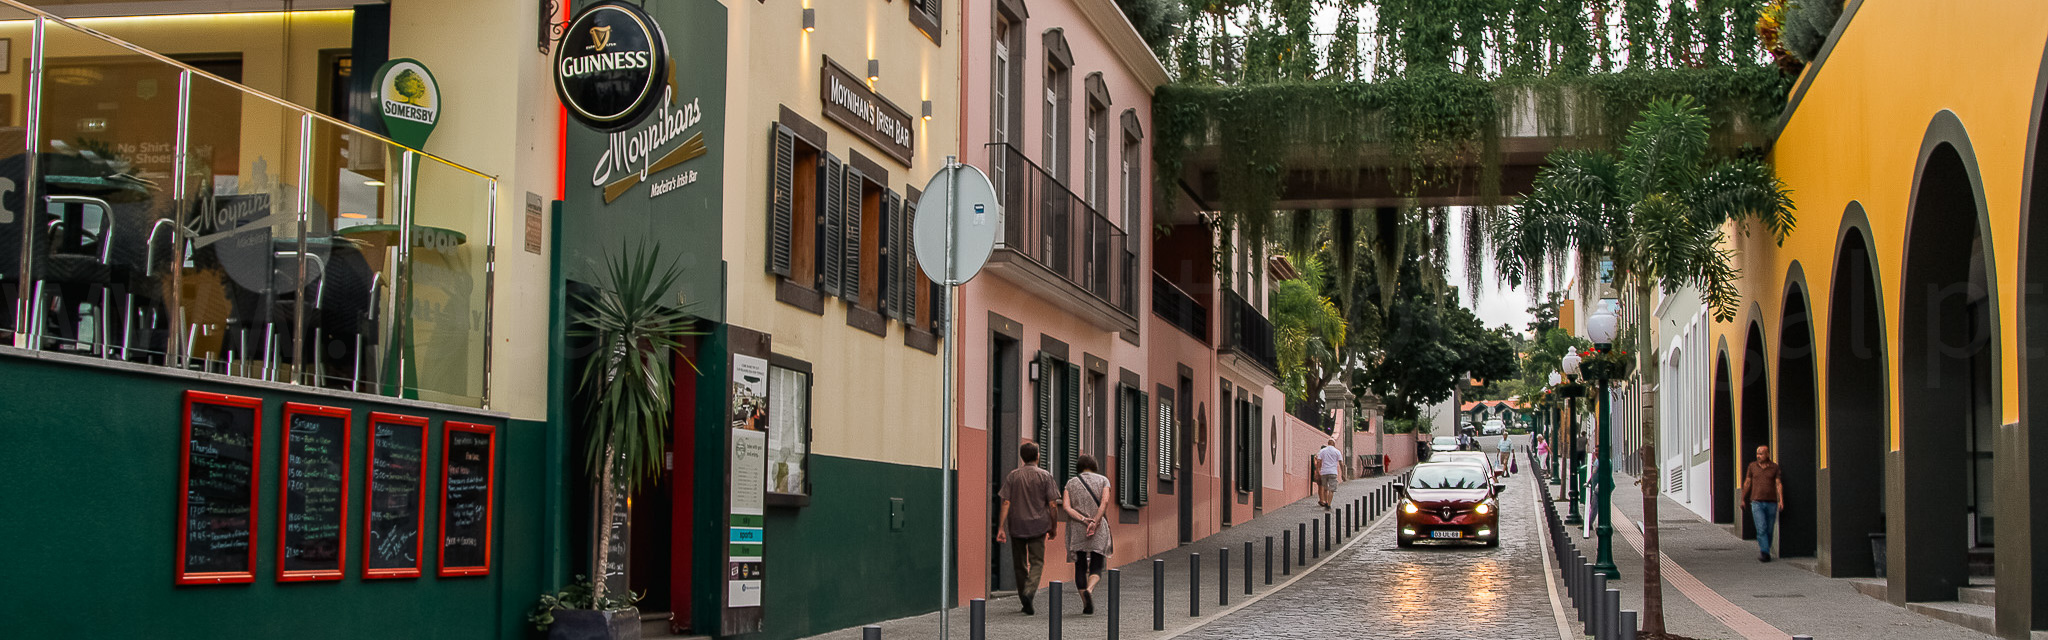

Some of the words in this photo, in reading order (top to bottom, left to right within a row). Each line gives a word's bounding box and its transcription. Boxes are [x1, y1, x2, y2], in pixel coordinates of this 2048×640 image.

[562, 50, 648, 78] GUINNESS
[384, 100, 434, 123] SOMERSBY
[830, 74, 875, 126] MOYNIHAN'S
[876, 106, 894, 138] IRISH
[895, 119, 909, 148] BAR
[140, 142, 170, 152] Shirt
[592, 84, 702, 186] Moynihans
[650, 176, 676, 198] Madeira's
[676, 172, 688, 188] Irish
[688, 170, 698, 183] Bar
[740, 531, 753, 540] sports
